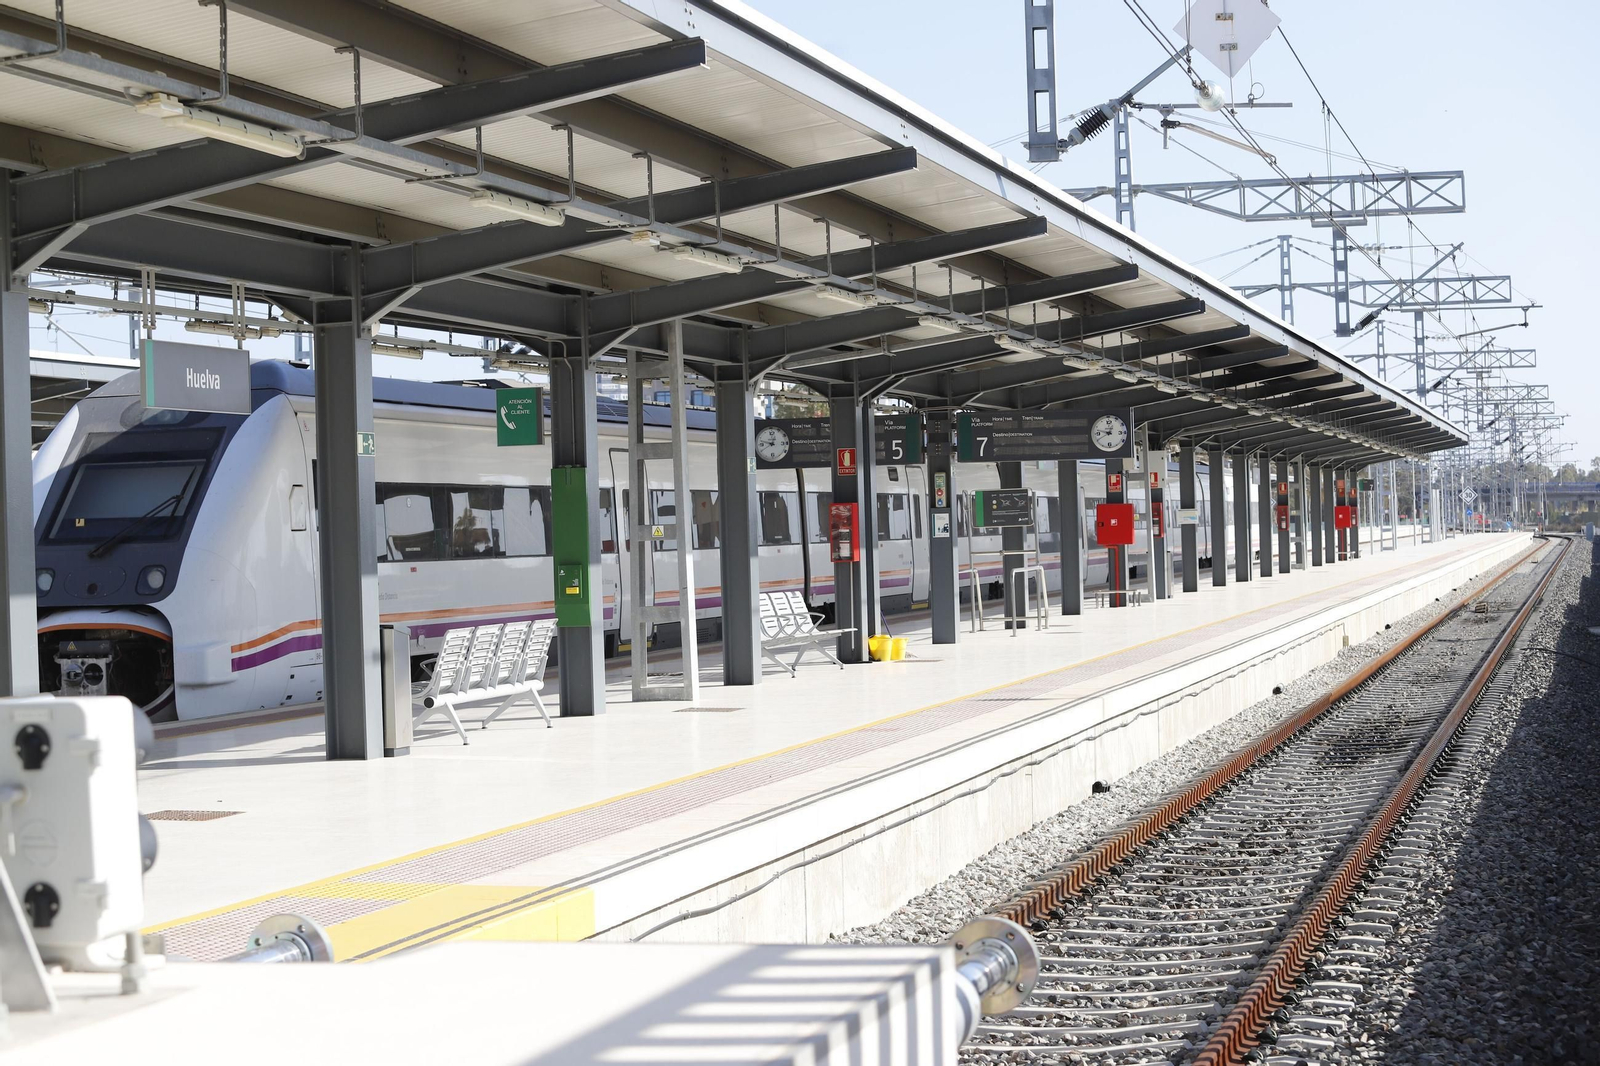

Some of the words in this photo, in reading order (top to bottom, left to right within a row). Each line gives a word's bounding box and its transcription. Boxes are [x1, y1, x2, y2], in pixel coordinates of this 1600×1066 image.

[186, 367, 220, 388] Huelva
[892, 439, 903, 460] 5
[976, 437, 988, 457] 7
